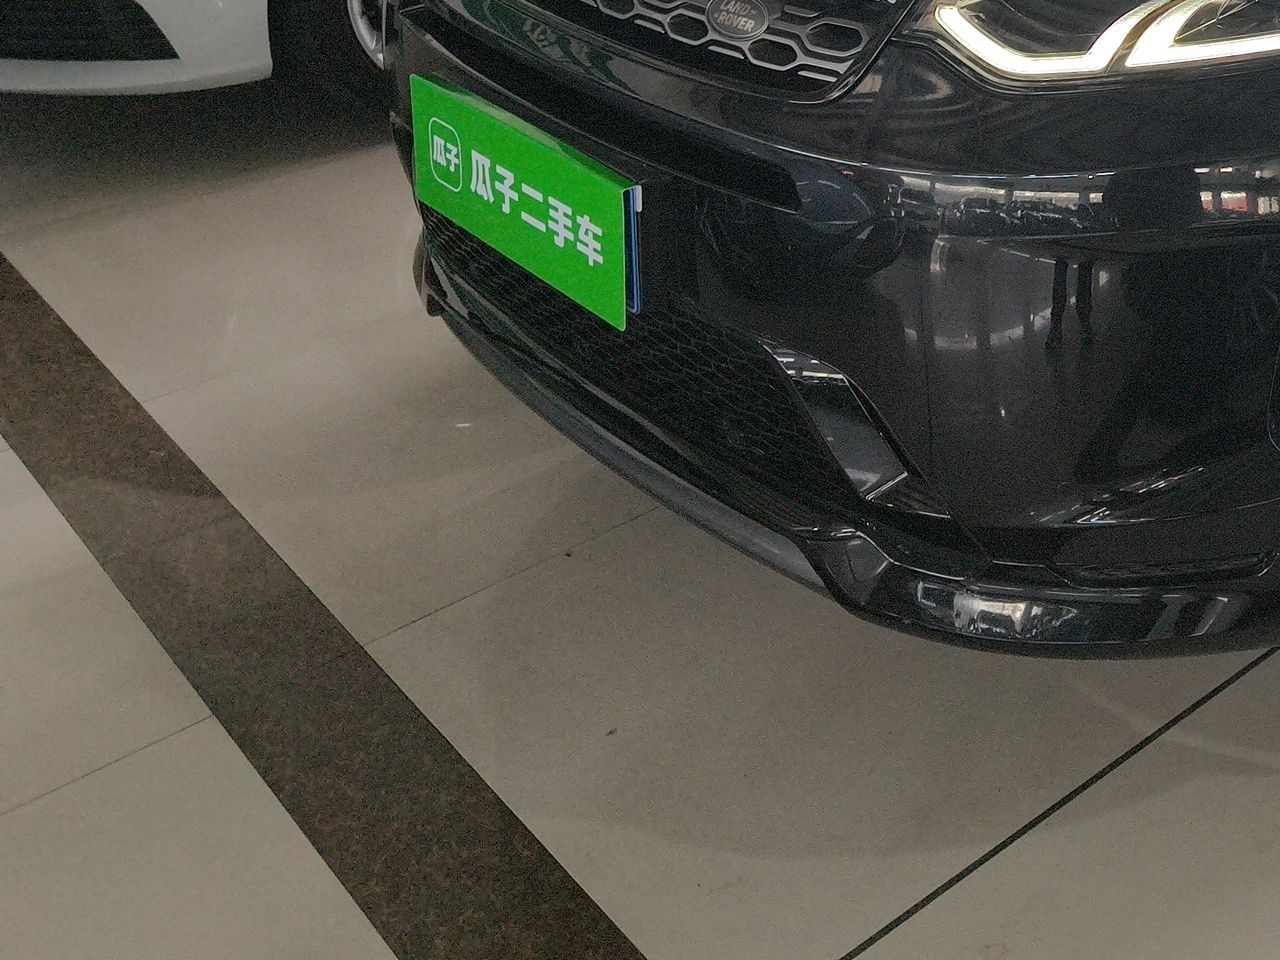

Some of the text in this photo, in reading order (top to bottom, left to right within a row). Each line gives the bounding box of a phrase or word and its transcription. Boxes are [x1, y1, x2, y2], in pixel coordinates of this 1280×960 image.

[717, 11, 756, 32] ROVER
[433, 134, 460, 172] 瓜子
[470, 149, 604, 267] 瓜子二手车
